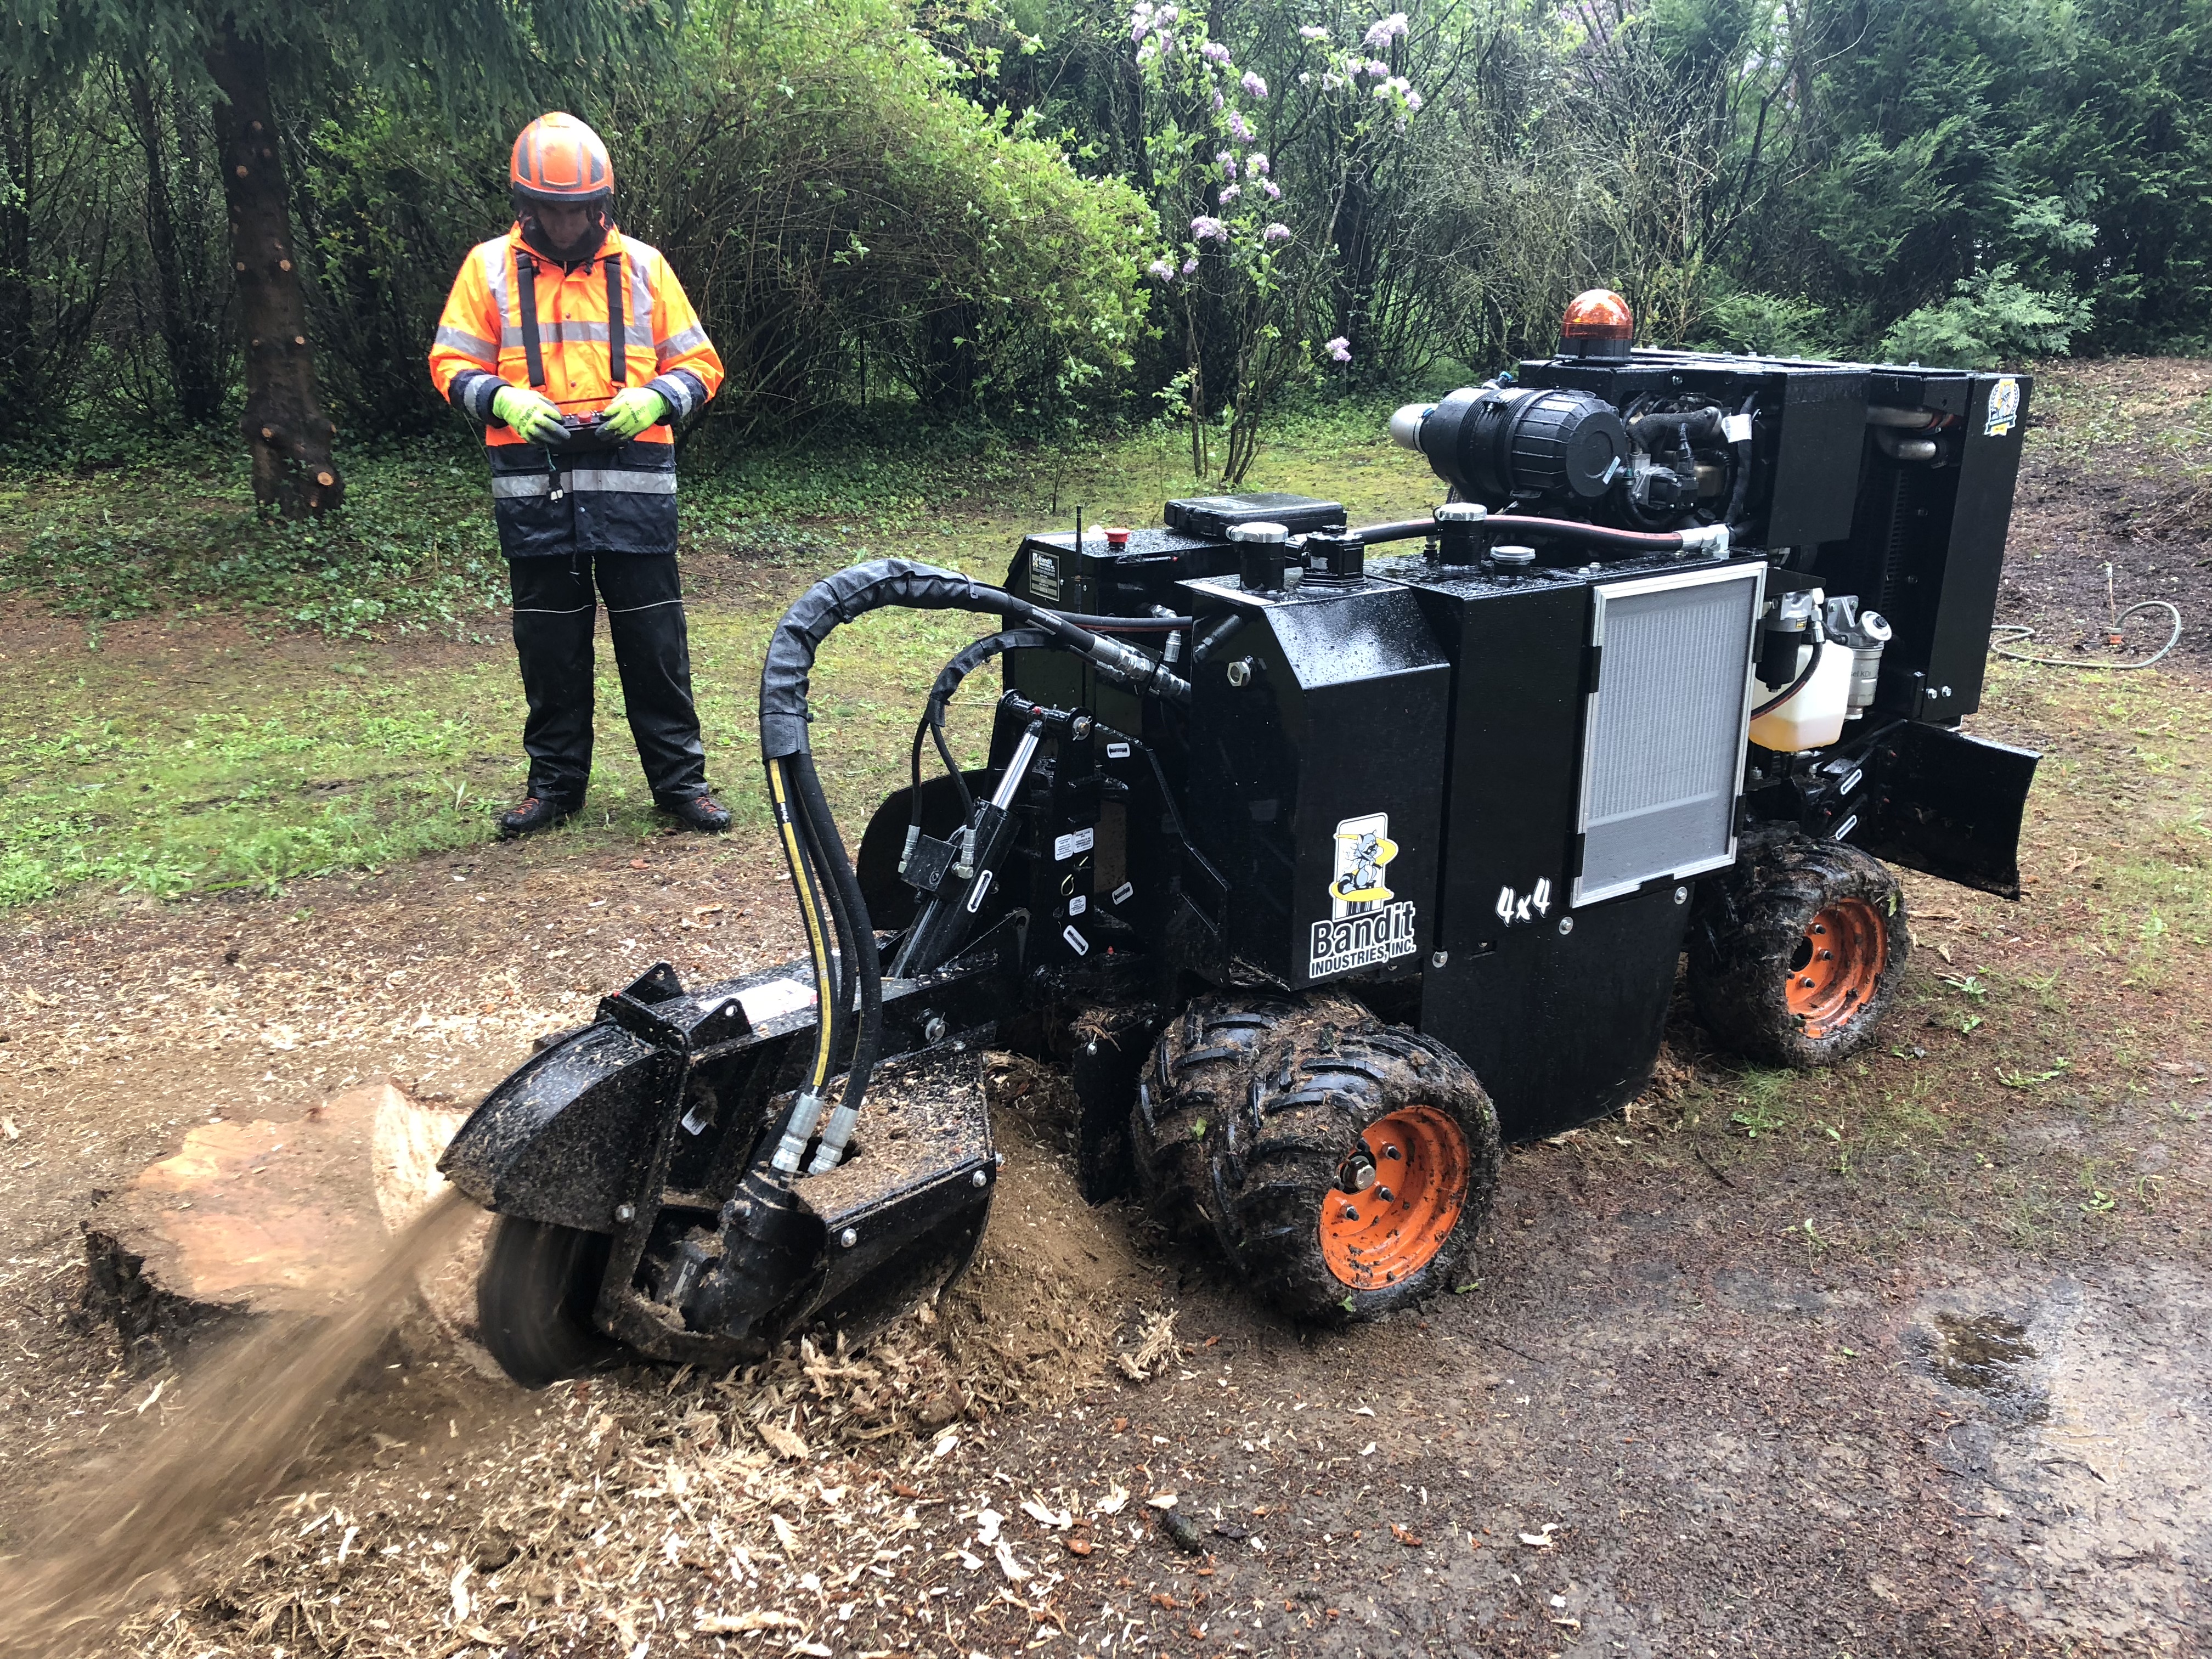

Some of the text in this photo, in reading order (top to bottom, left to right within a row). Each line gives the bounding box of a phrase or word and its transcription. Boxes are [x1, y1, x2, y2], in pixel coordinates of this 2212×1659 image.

[1496, 877, 1551, 926] 4x4
[1312, 902, 1414, 960] Bandit
[1311, 938, 1415, 977] INDUSTRIES, INC.
